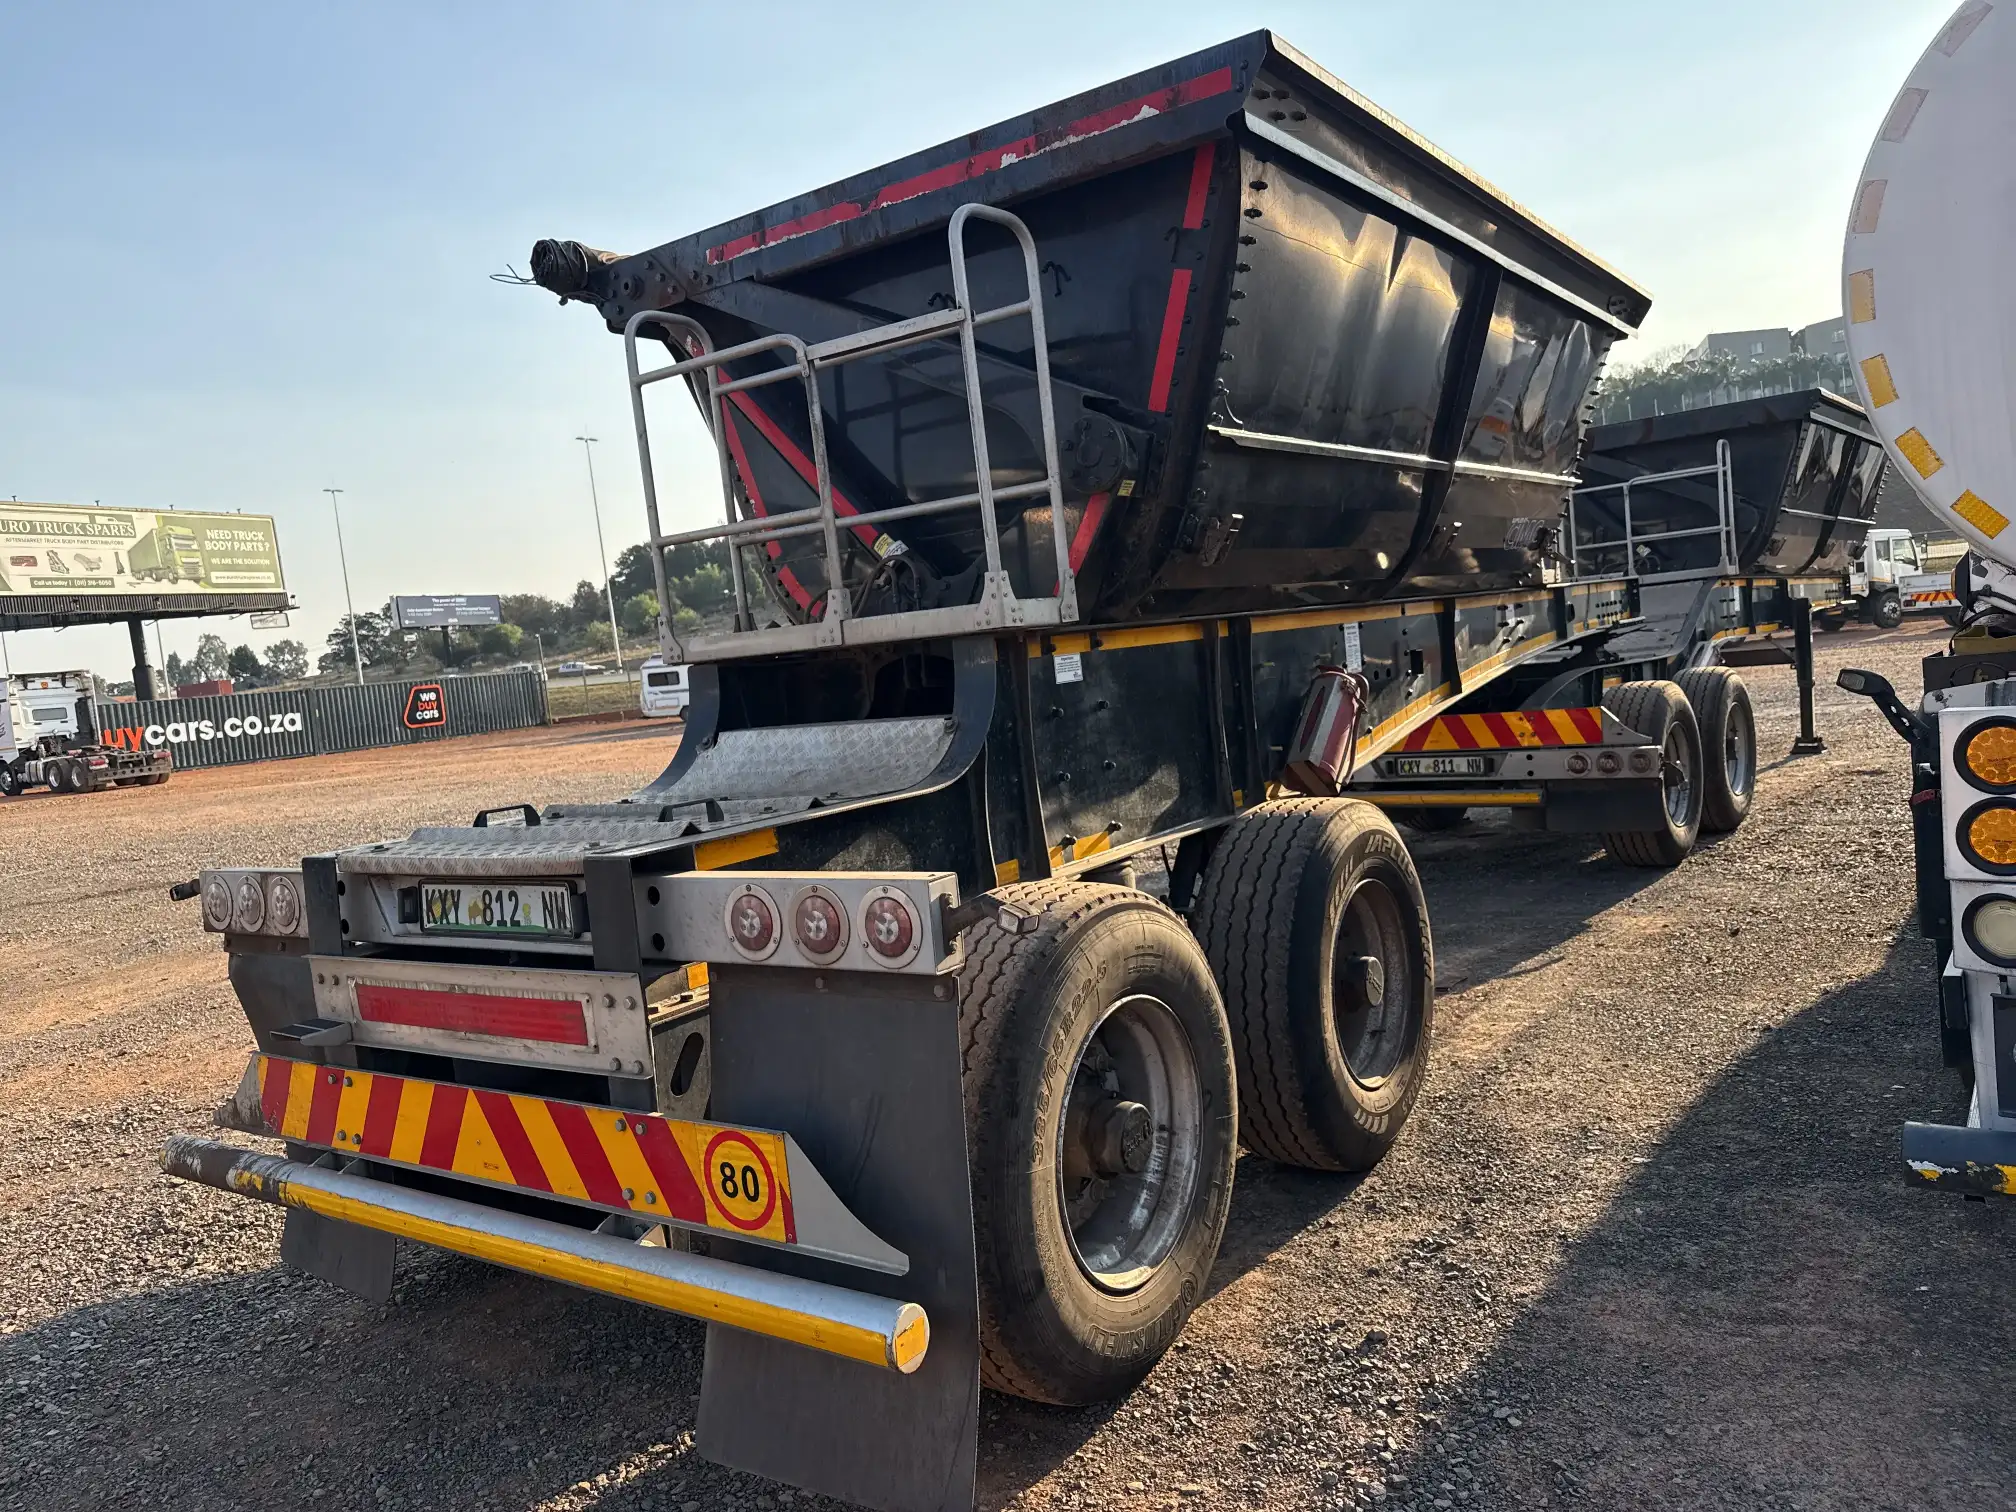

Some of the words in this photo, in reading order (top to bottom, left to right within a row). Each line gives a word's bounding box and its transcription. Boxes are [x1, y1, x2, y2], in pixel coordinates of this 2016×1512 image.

[0, 520, 30, 533] URO
[33, 521, 84, 535] TRUCK
[86, 523, 135, 536] SPARES
[206, 529, 232, 540] NEED
[232, 530, 264, 541] TRUCK
[205, 541, 232, 550] BODY
[419, 692, 436, 701] we
[418, 701, 437, 710] buy
[416, 710, 439, 720] cars
[101, 712, 302, 752] uycars.co.za
[1400, 759, 1421, 774] KXY
[1433, 759, 1455, 773] 811
[1467, 758, 1482, 773] NW
[425, 889, 461, 925] KXY
[482, 889, 520, 927] 812
[541, 891, 568, 929] NW
[720, 1161, 760, 1203] 80
